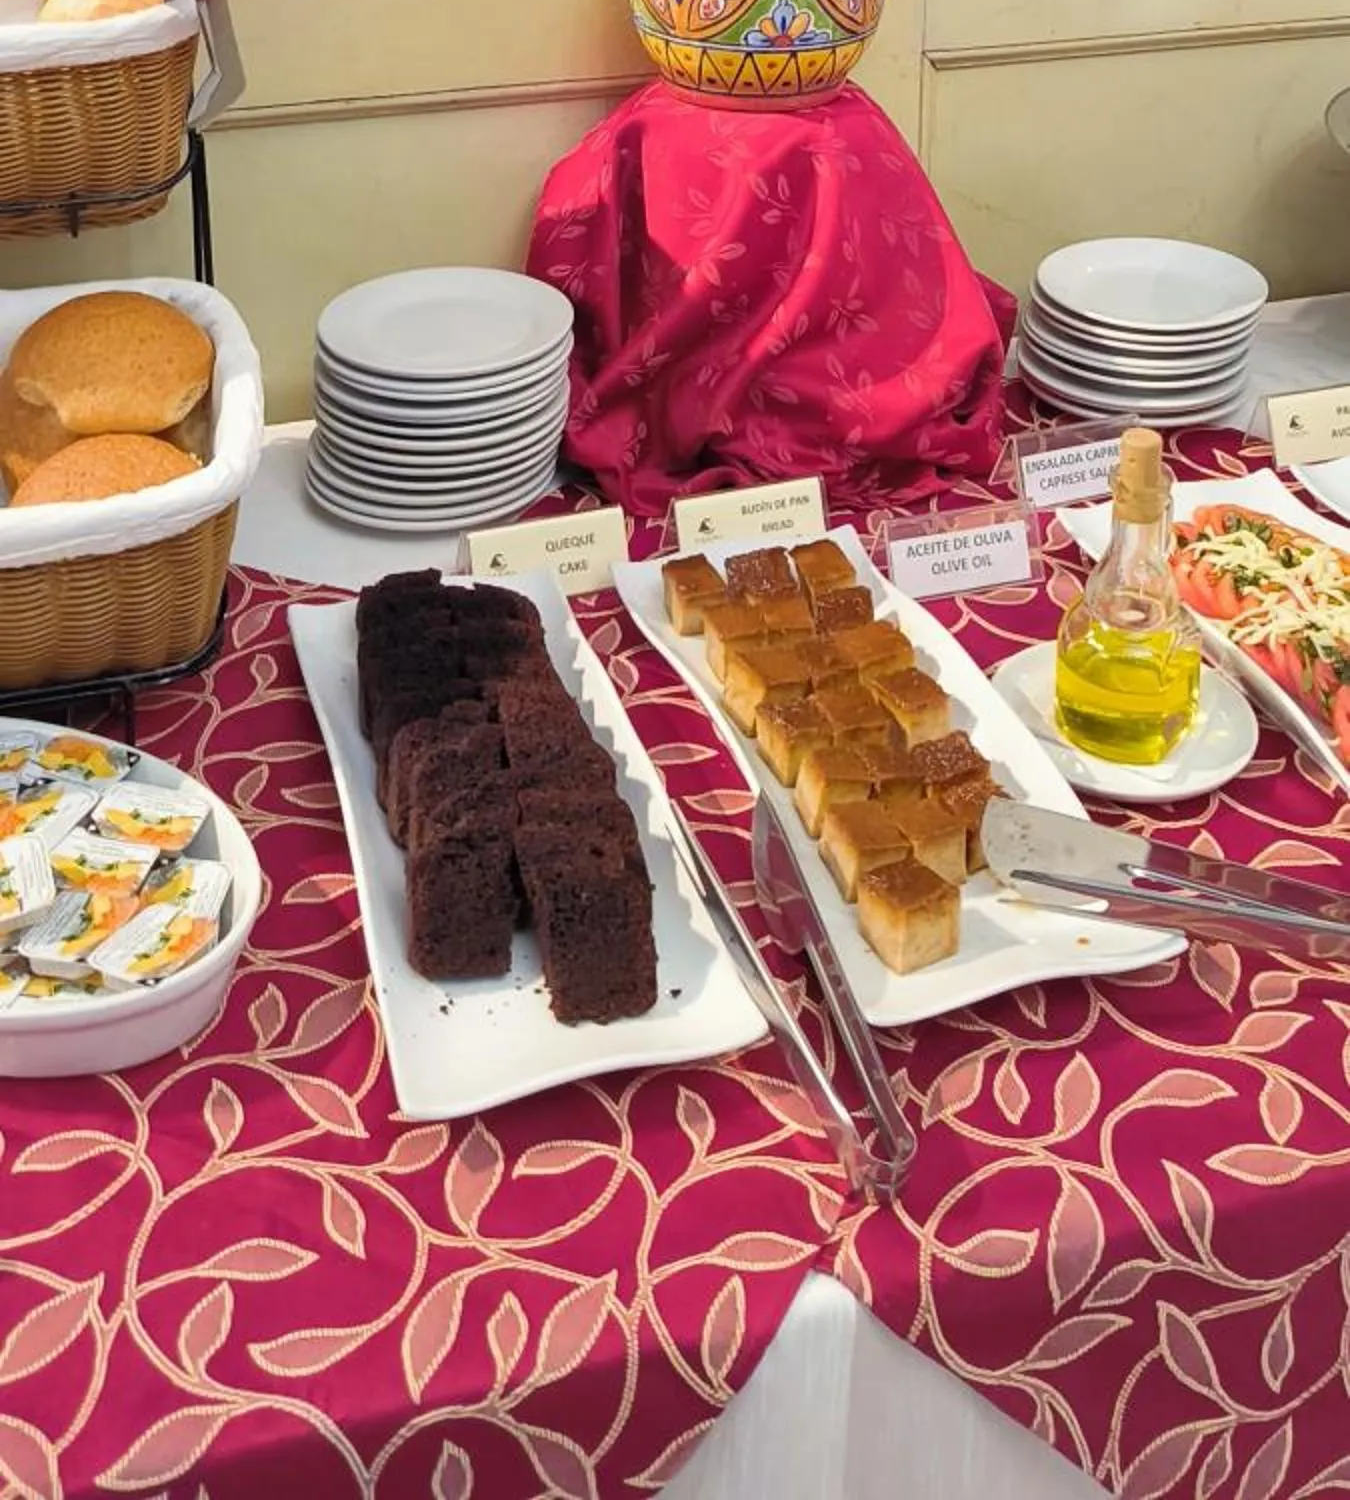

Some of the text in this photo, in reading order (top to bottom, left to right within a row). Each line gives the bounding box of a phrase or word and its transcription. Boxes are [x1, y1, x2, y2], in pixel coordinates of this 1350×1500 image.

[1025, 452, 1083, 474] ENSALADA
[1040, 469, 1086, 490] CAPRESE
[774, 498, 786, 510] DE
[789, 495, 810, 507] PAN
[545, 532, 595, 553] QUEQUE
[906, 529, 1013, 558] ACEITE DE OLIVA
[558, 559, 588, 575] CAKE
[931, 554, 993, 575] OLIVE OIL
